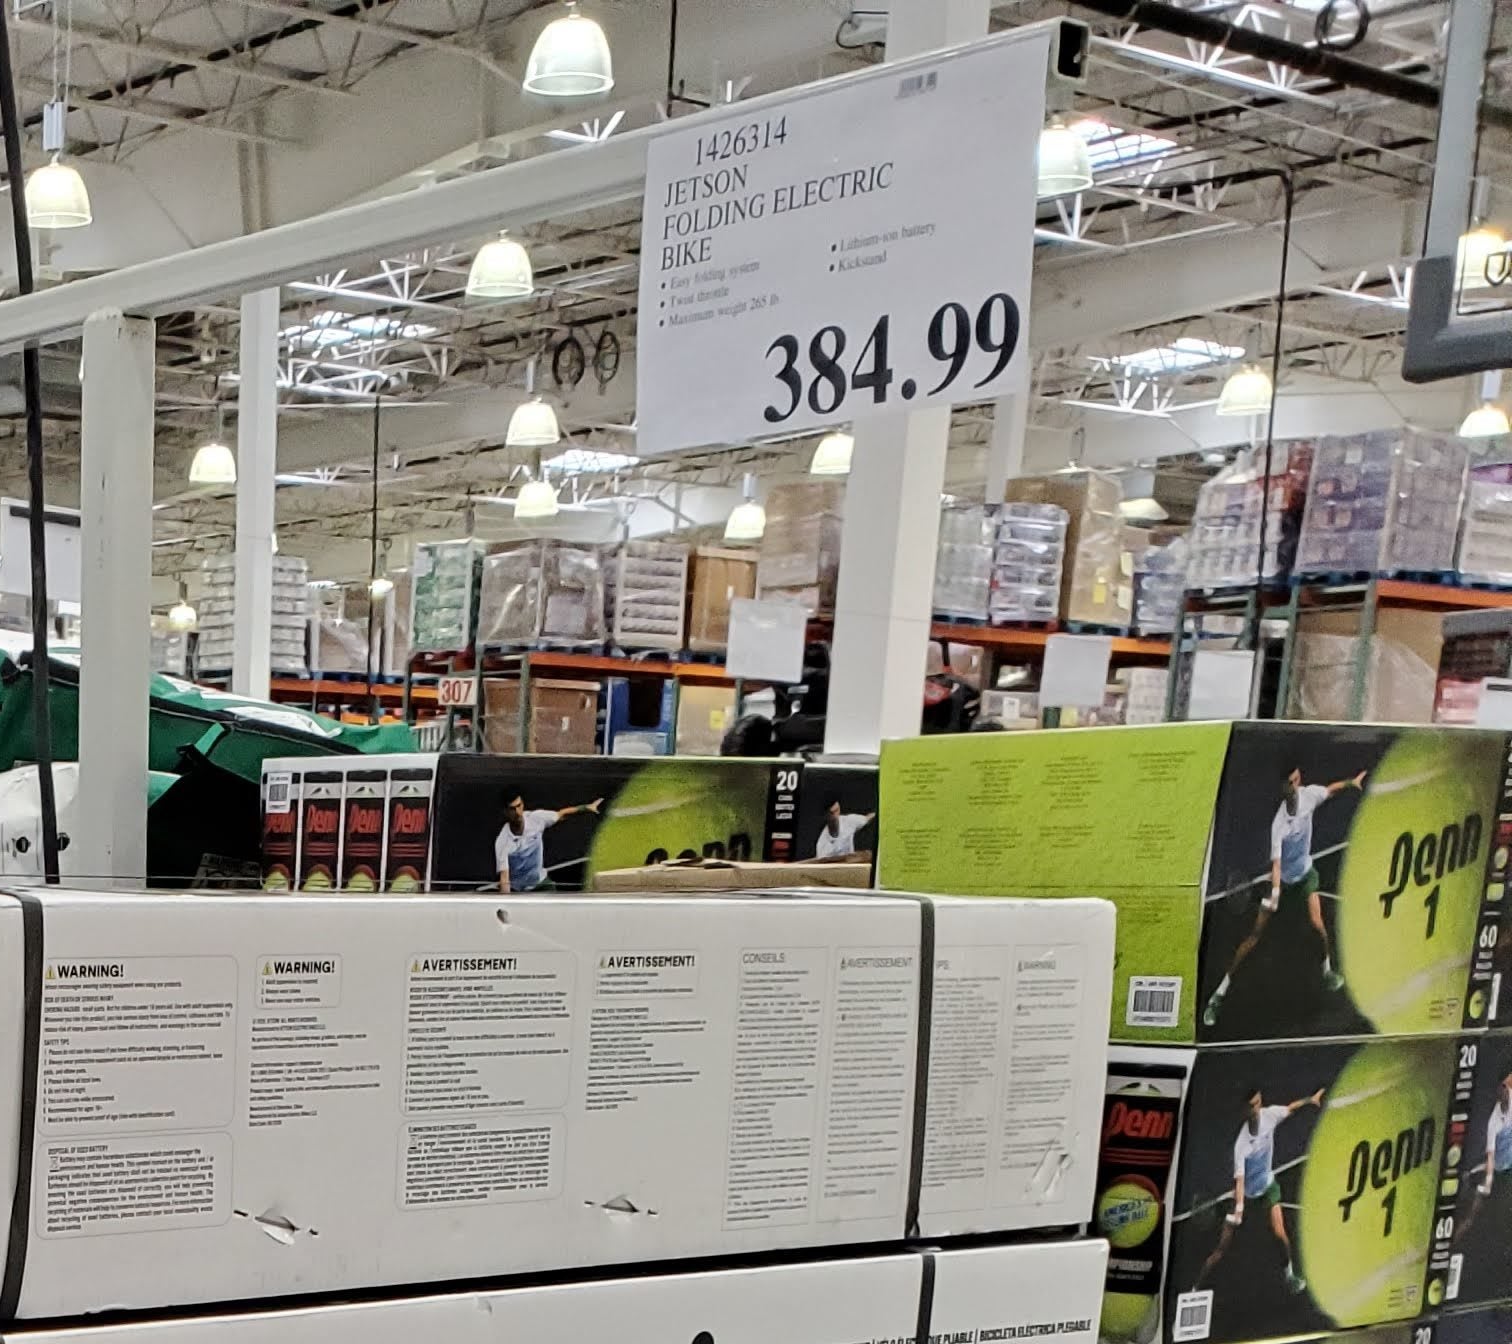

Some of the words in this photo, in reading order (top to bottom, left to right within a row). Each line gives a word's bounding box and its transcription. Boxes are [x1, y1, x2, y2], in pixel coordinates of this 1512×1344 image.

[695, 116, 788, 165] 1426314
[663, 194, 765, 240] FOLDING
[772, 162, 894, 214] ELECTRIC
[664, 165, 748, 207] JETSON
[661, 237, 712, 271] BIKE
[763, 292, 1020, 423] 384.99
[441, 679, 473, 703] 307
[776, 771, 798, 791] 20
[1379, 813, 1483, 919] Penn
[1424, 884, 1440, 940] 1
[57, 965, 124, 978] WARNING!
[274, 961, 335, 974] WARNING!
[422, 959, 517, 972] AVERTISSEMENT!
[608, 955, 695, 968] AVERTISSEMENT!
[743, 952, 785, 964] CONSEILS
[1338, 1115, 1436, 1224] Penn
[1381, 1186, 1397, 1238] 1
[980, 1327, 1016, 1343] BICICLETA
[1017, 1322, 1055, 1339] ELÉCTRICA
[1057, 1319, 1092, 1333] PLEGABLE
